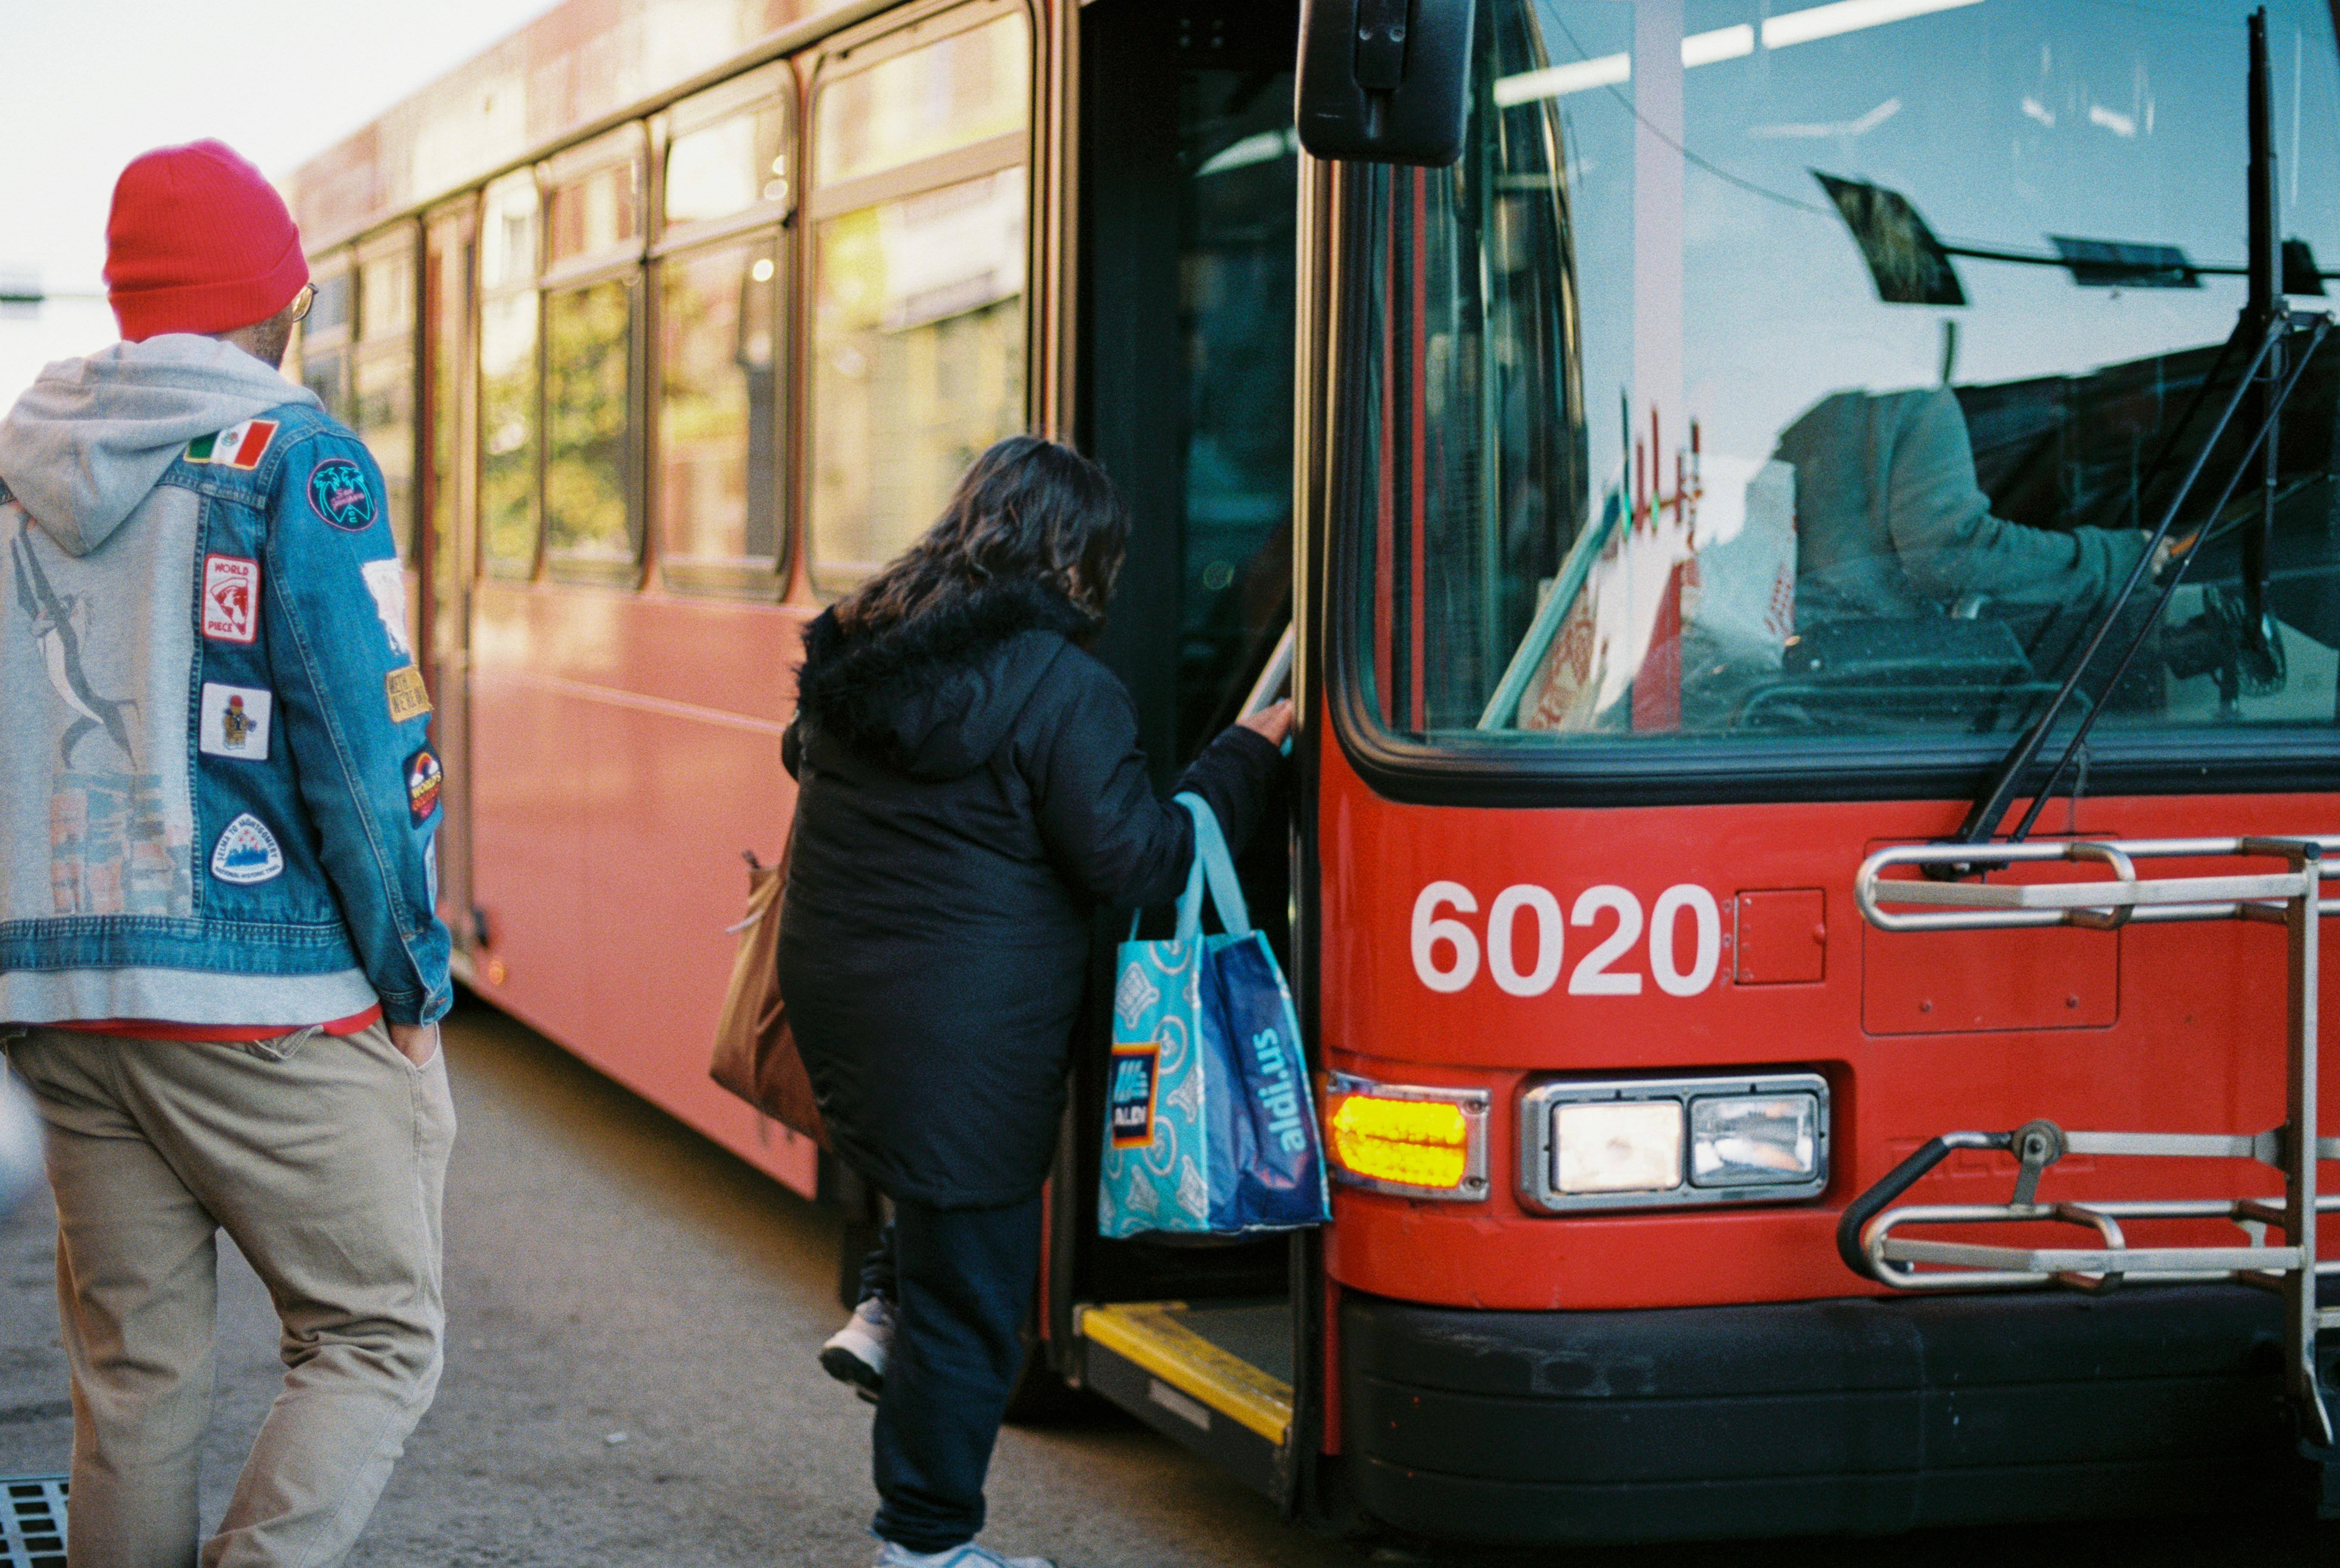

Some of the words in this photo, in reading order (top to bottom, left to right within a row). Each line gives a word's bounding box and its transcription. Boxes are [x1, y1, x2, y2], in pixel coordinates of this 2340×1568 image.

[215, 563, 249, 575] WORLD
[208, 621, 233, 632] PIECE
[217, 836, 231, 861] SELMA
[228, 825, 238, 835] TO
[239, 818, 278, 858] MONTGOMERY
[1410, 880, 1721, 997] 6020
[1253, 1028, 1306, 1152] aldi.us
[1115, 1106, 1147, 1126] ALDI
